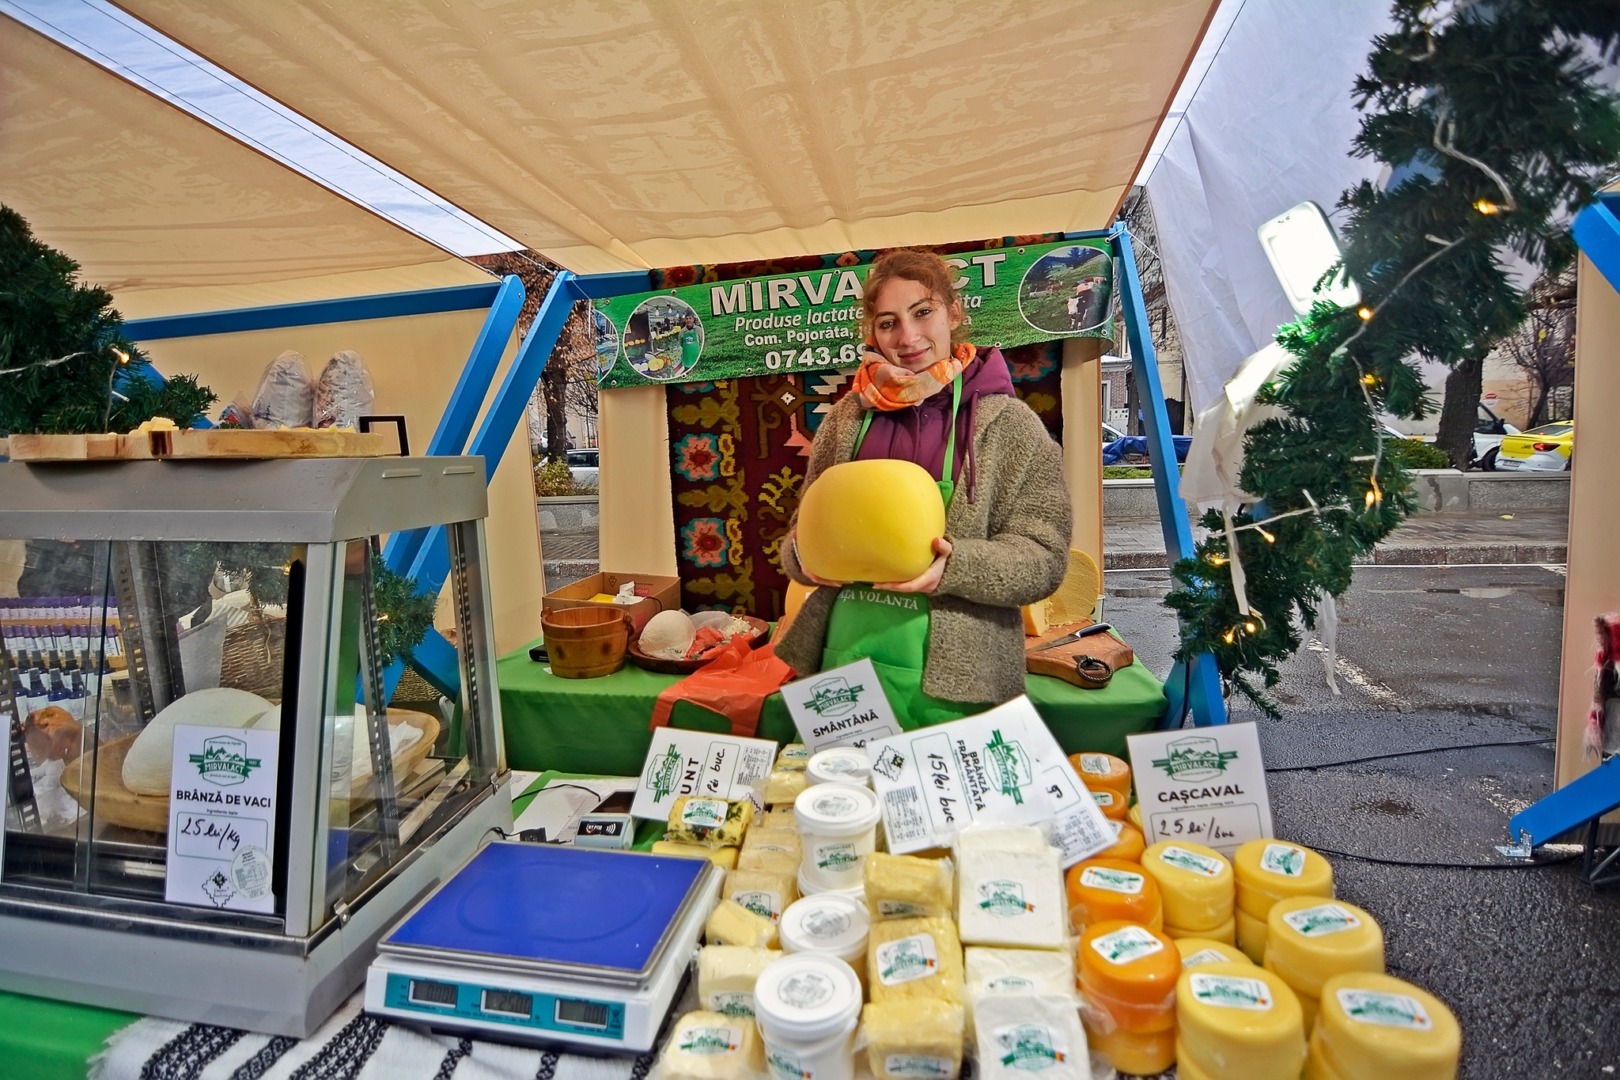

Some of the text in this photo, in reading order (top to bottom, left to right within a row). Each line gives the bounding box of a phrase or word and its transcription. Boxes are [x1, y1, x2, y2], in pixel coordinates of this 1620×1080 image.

[734, 308, 864, 332] Produse lactate
[744, 333, 782, 347] Com.
[787, 327, 854, 345] Pojorâta,
[859, 591, 919, 610] VOLANTĂ
[812, 709, 879, 737] SMÂNTÂNĂ
[204, 762, 244, 774] MIRVALACT
[710, 748, 726, 772] buc
[1172, 760, 1219, 773] MIRVALACT
[680, 758, 699, 795] UNT
[969, 751, 991, 795] BRÂNZĂ
[176, 788, 271, 808] BRÂNZĂ DE VACI
[1158, 784, 1245, 804] CAȘCAVAL
[940, 798, 957, 823] buc
[181, 817, 206, 836] 25
